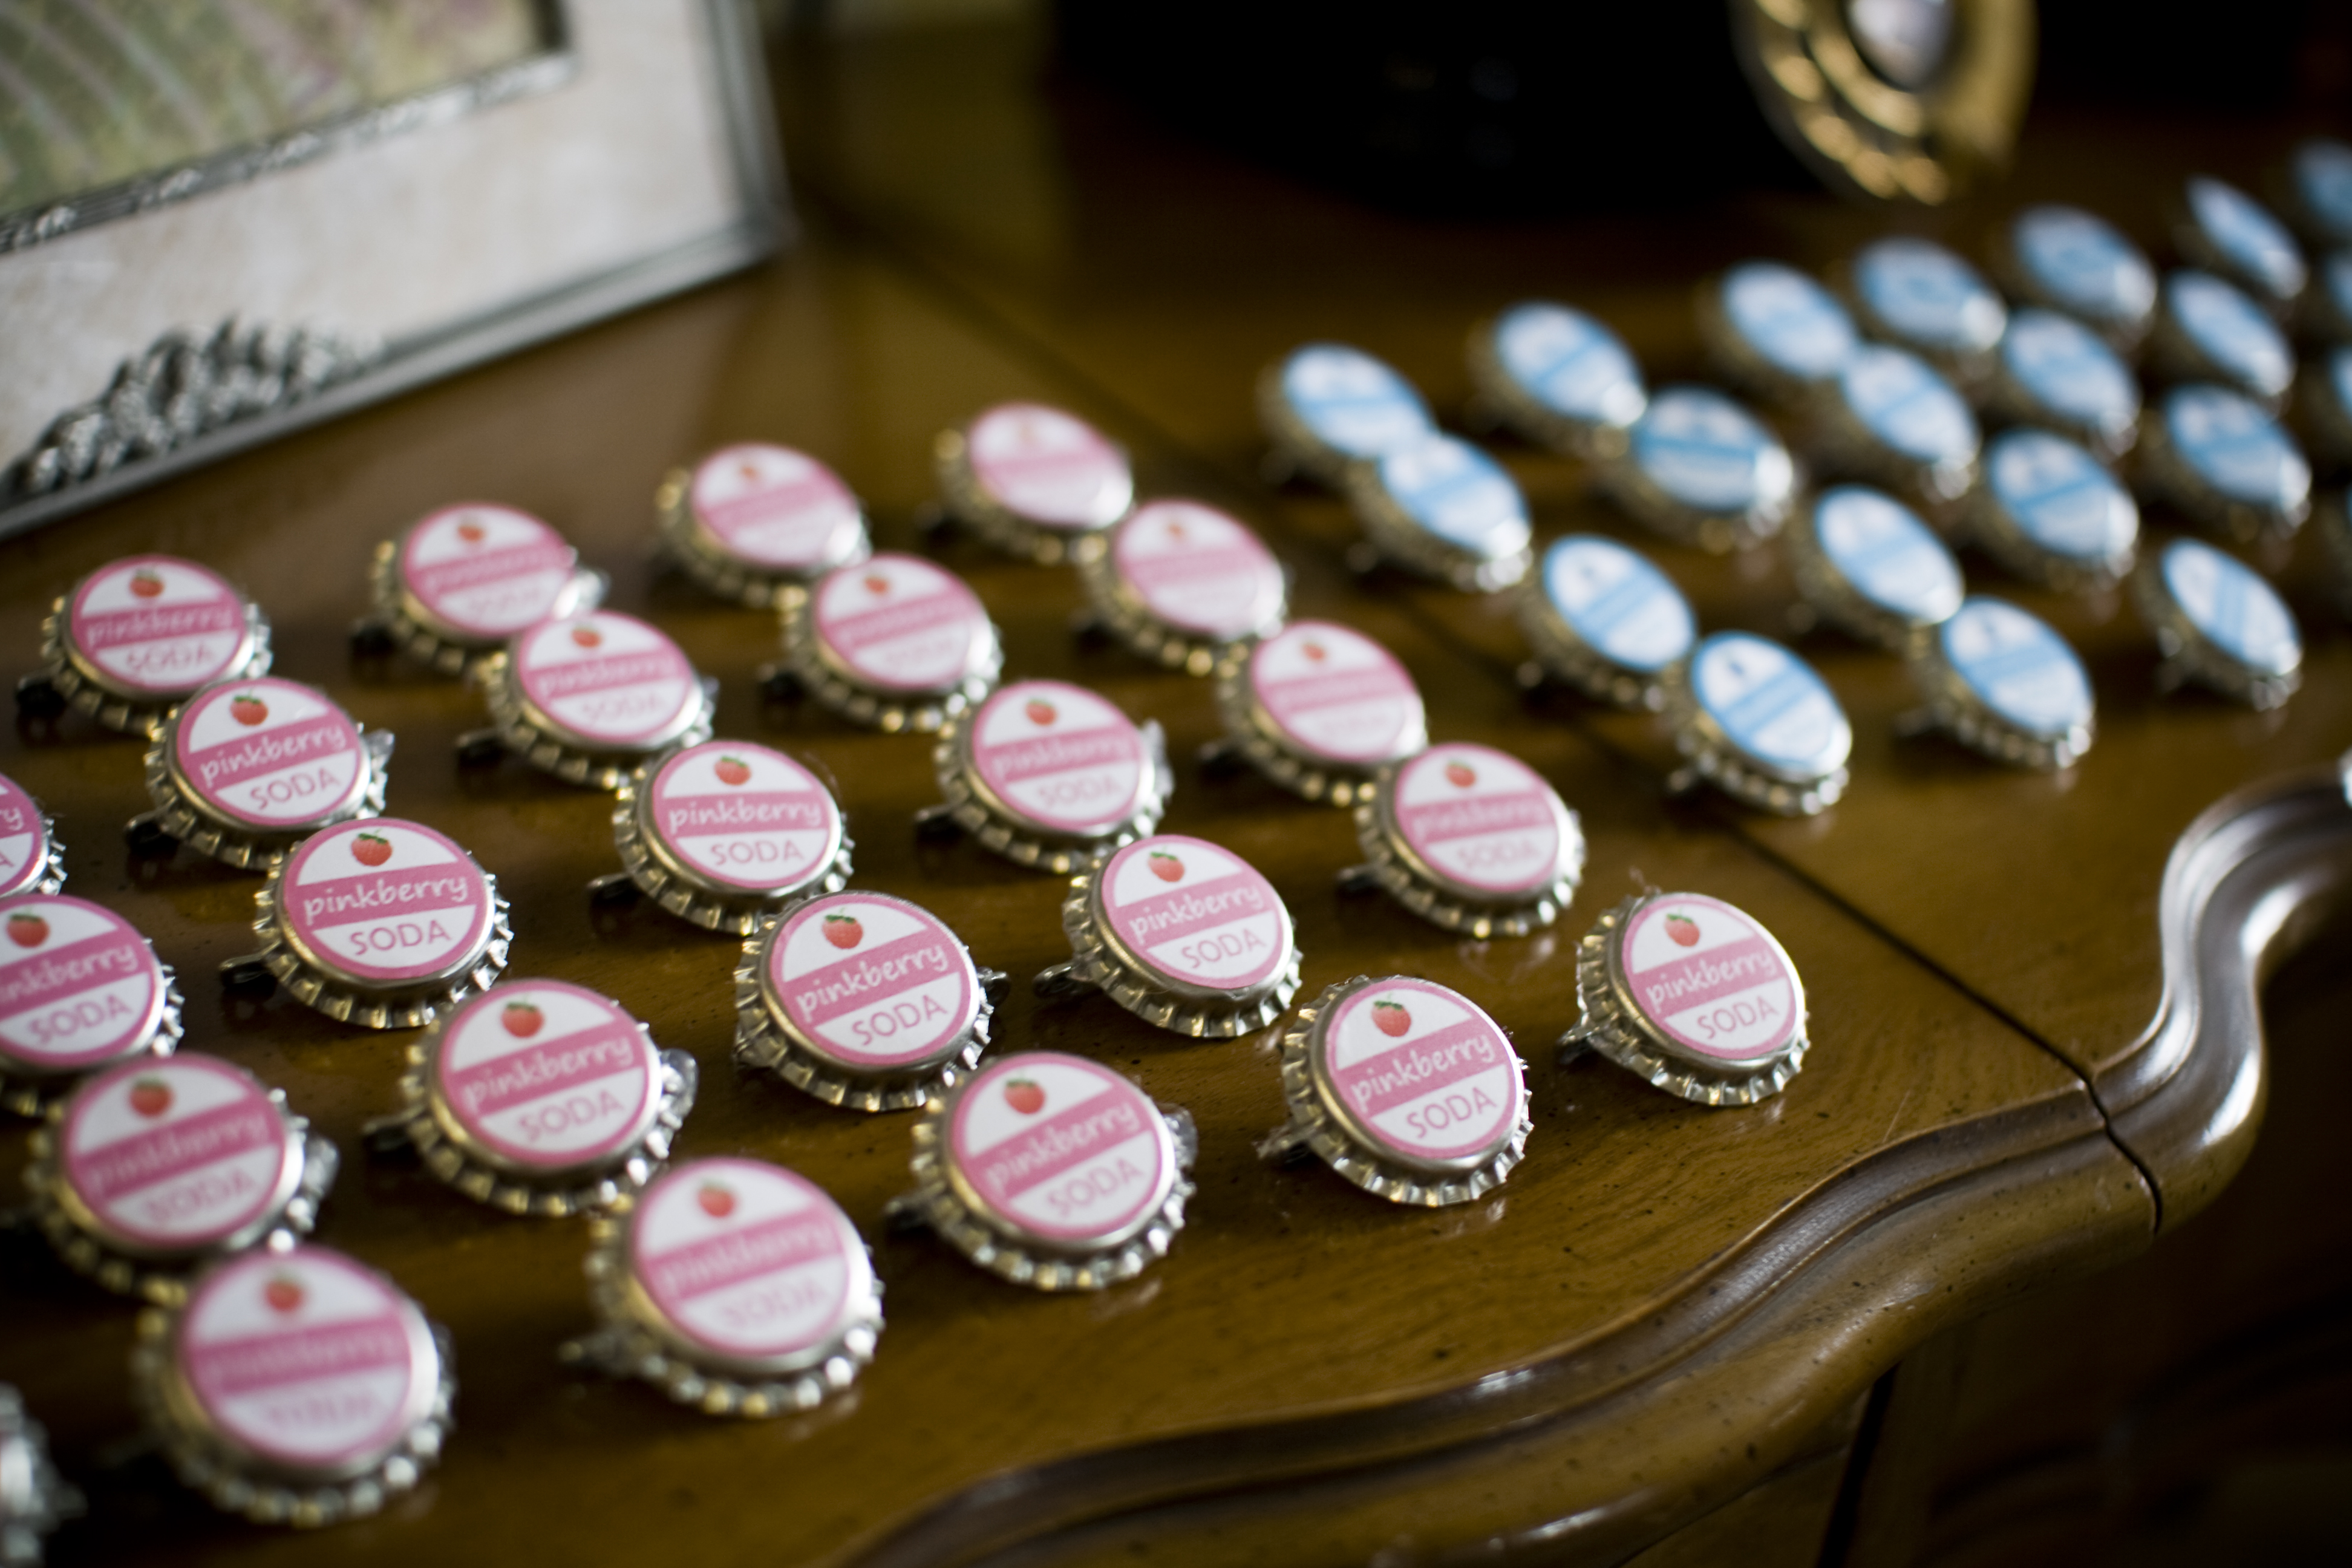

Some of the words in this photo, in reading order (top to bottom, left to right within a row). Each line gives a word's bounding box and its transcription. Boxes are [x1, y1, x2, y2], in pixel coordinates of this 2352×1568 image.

[200, 724, 347, 786] pinkberry
[250, 765, 342, 809] SODA
[668, 797, 821, 834] pinkberry
[709, 841, 803, 866] SODA
[303, 874, 469, 924] pinkberry
[1129, 886, 1261, 946] pinkberry
[350, 920, 451, 955] SODA
[1182, 929, 1267, 968] SODA
[0, 945, 138, 1002] nkberry
[796, 946, 946, 1017] pinkberry
[1647, 950, 1773, 1013] pinkberry
[28, 995, 132, 1043] SODA
[852, 996, 948, 1045] SODA
[1697, 997, 1779, 1039] SODA
[466, 1036, 633, 1105] pinkberry
[1349, 1033, 1494, 1114] pinkberry
[518, 1091, 625, 1142] SODA
[1406, 1088, 1497, 1137] SODA
[987, 1105, 1142, 1192] pinkberry
[1048, 1159, 1143, 1216] SODA
